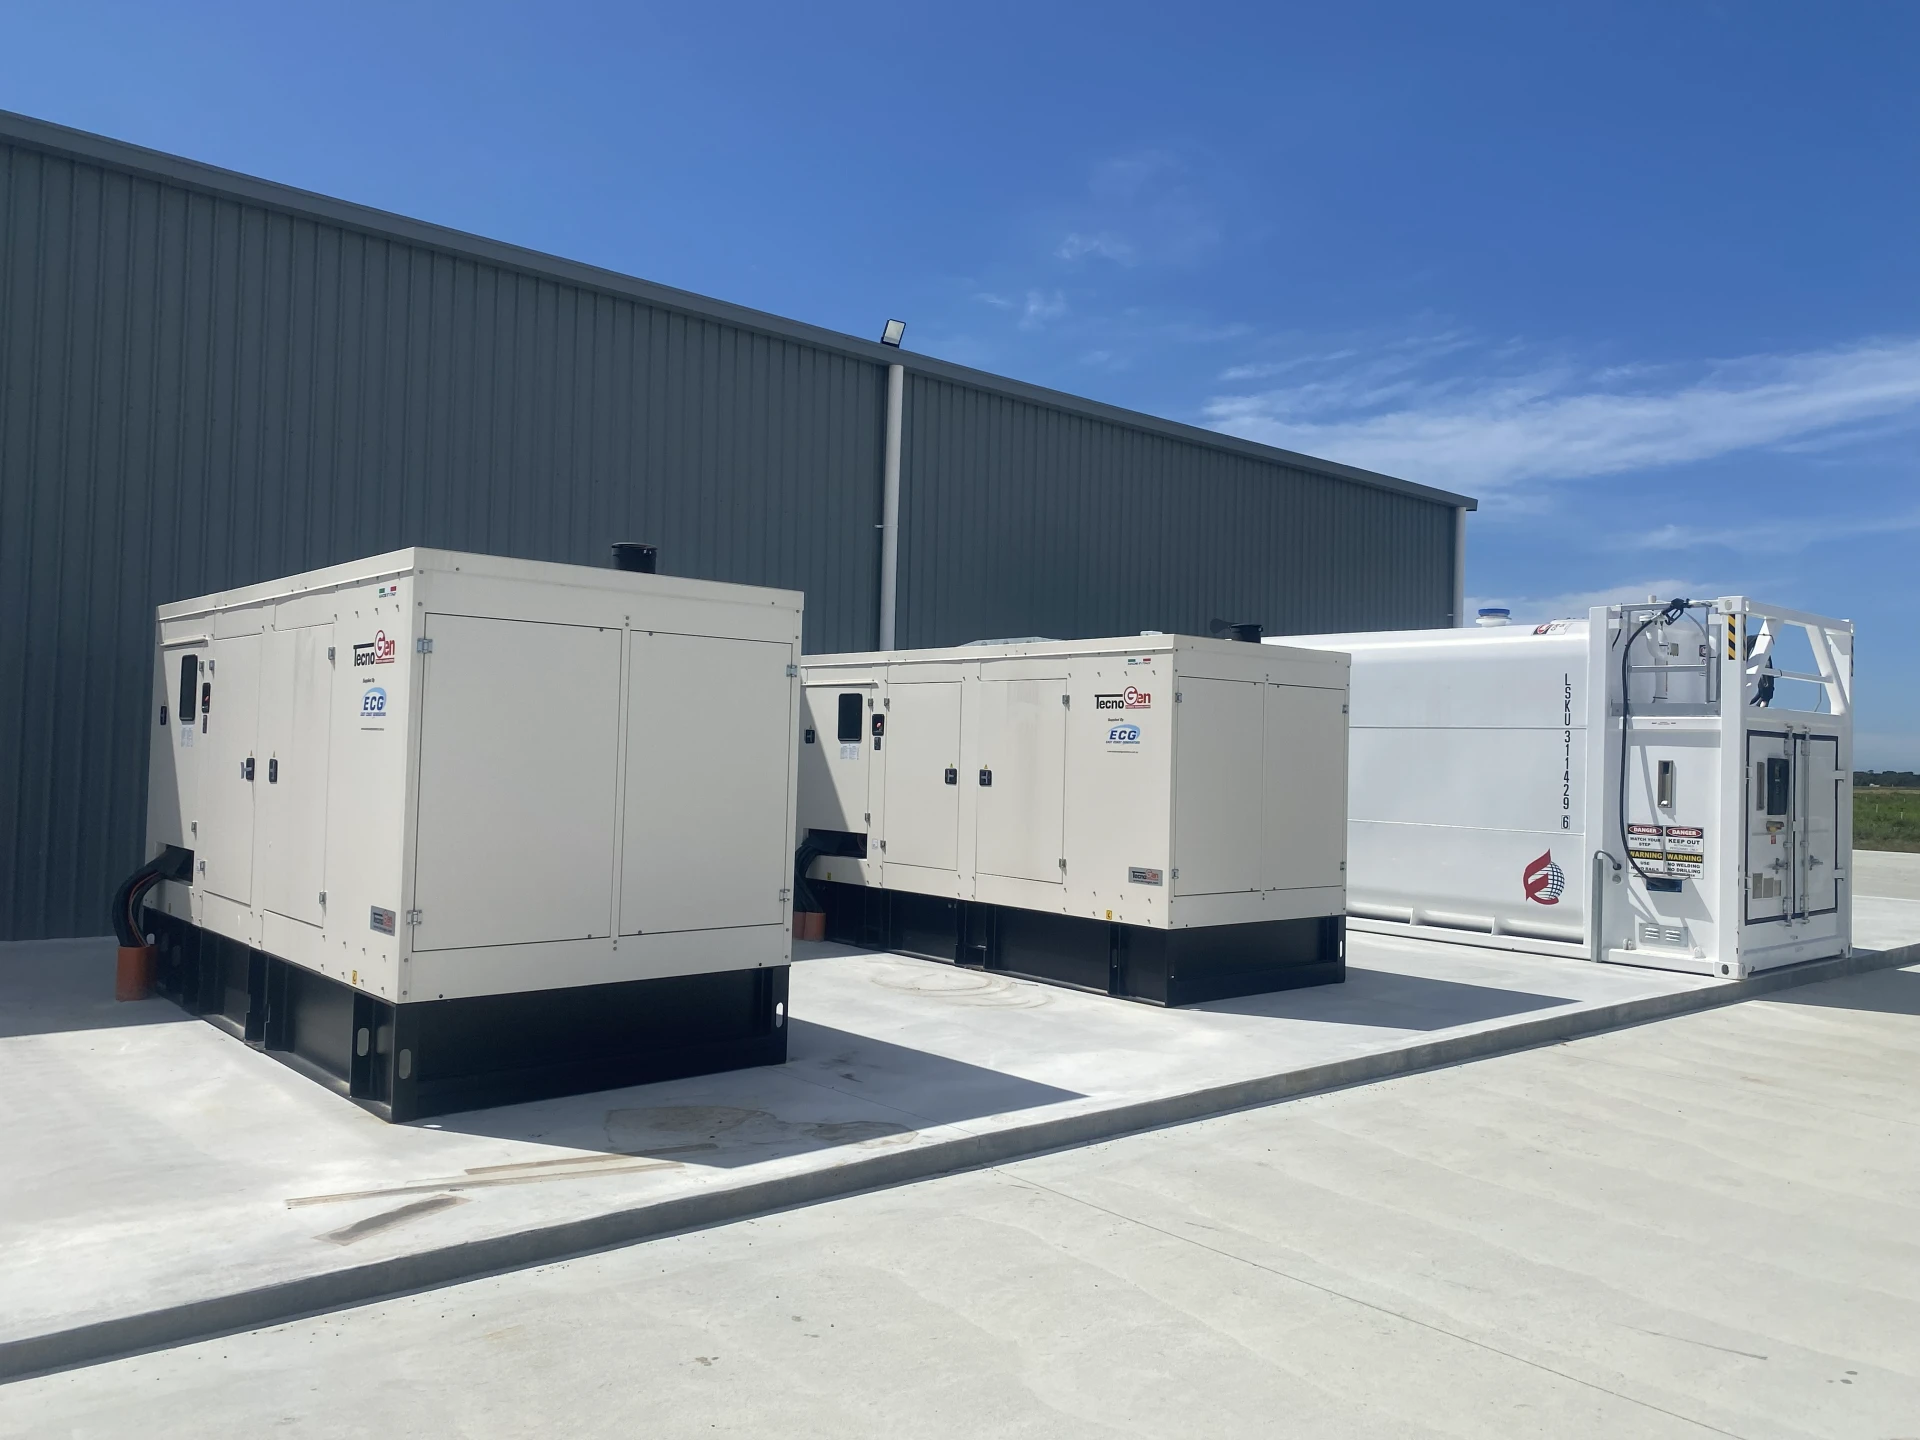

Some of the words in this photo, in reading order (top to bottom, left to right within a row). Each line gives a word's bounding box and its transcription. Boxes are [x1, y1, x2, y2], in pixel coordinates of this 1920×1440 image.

[353, 630, 395, 667] TecnoGen
[363, 696, 385, 711] ECG
[1094, 686, 1151, 709] TecnoGen
[1109, 730, 1137, 740] ECG
[1563, 730, 1571, 810] 311429
[1667, 853, 1702, 862] WARNING
